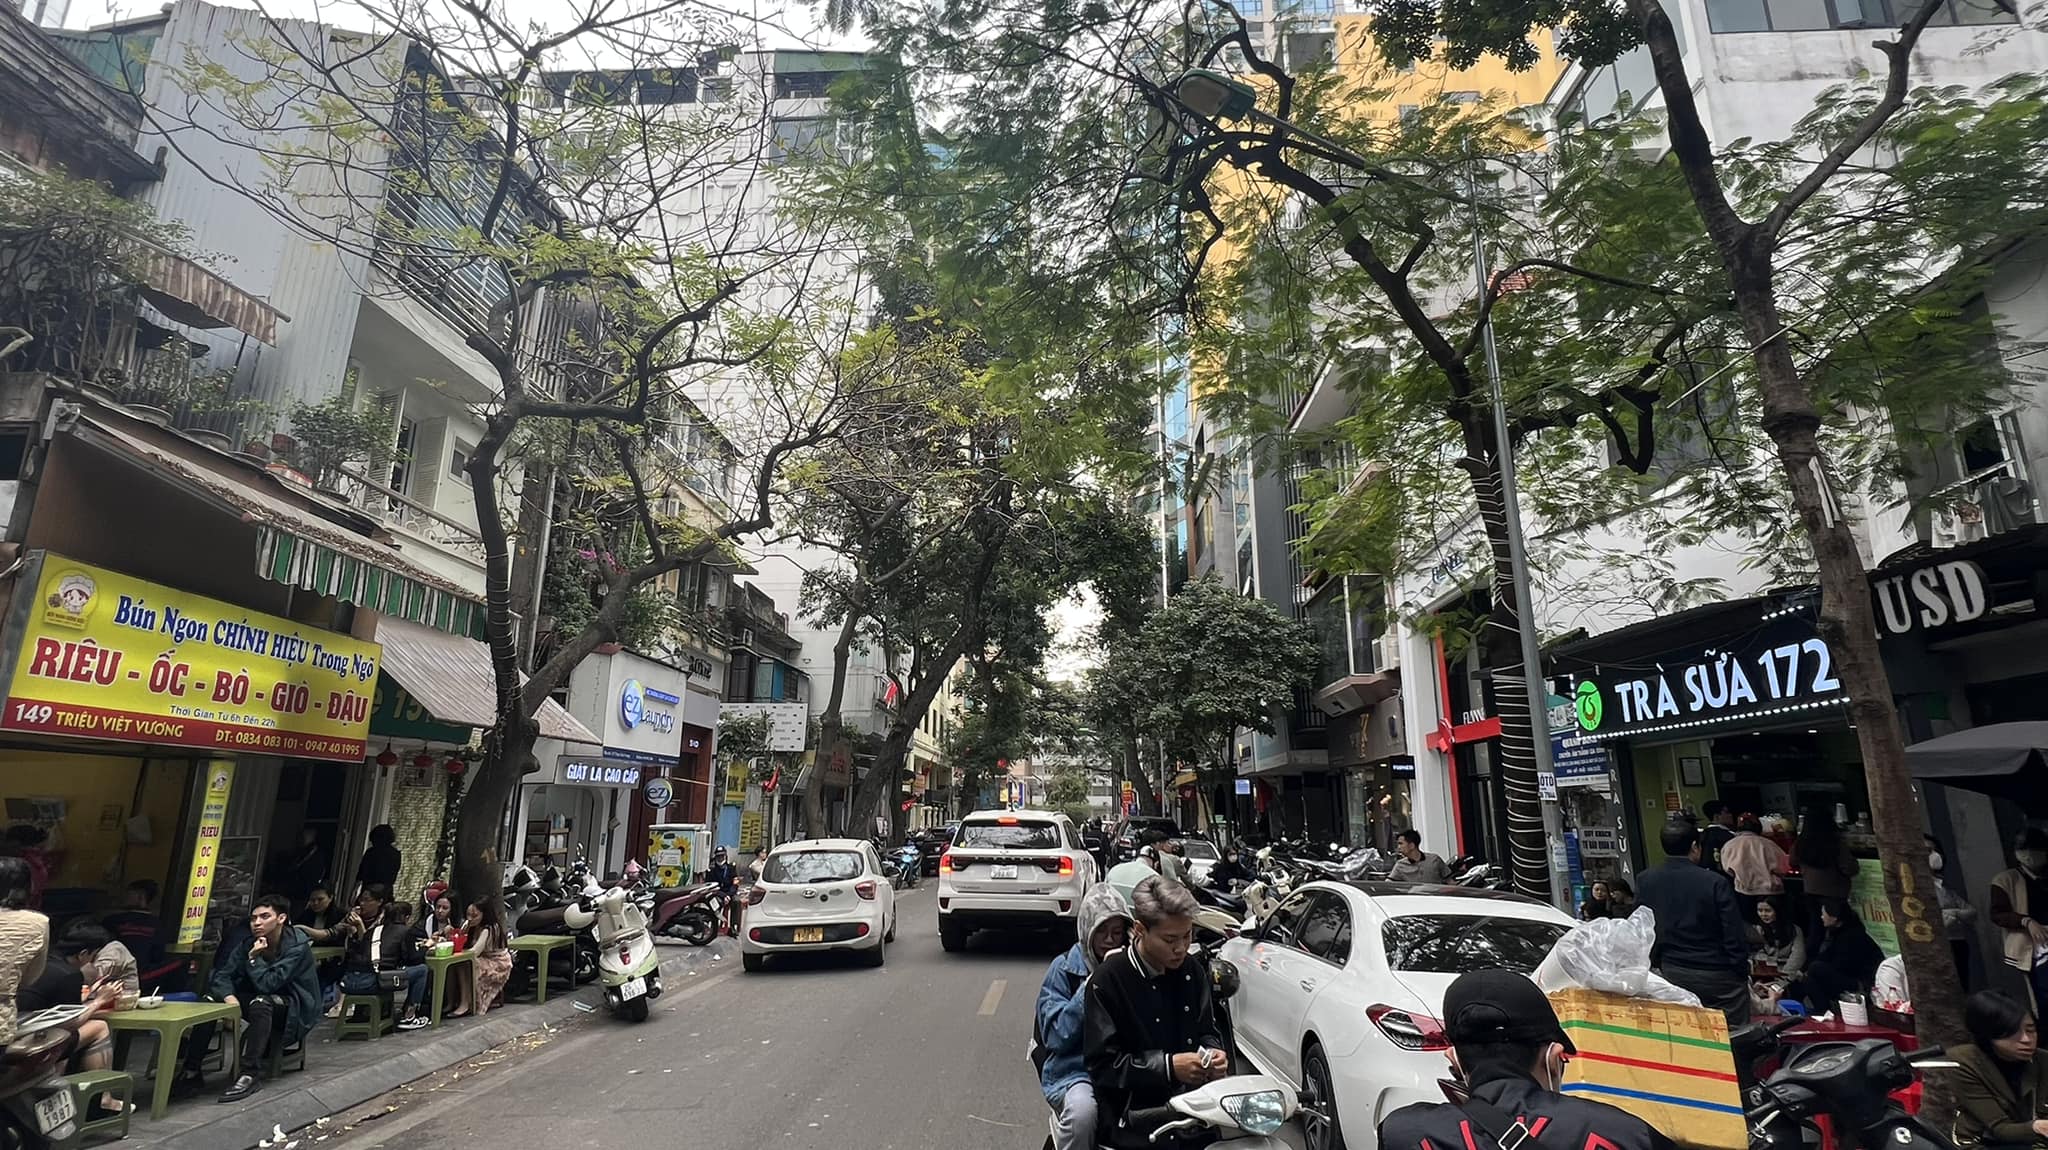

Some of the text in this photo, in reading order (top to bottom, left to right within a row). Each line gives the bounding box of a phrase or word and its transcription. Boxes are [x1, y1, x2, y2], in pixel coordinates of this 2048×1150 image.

[1874, 560, 1986, 639] USD
[115, 595, 155, 630] Bún
[161, 606, 207, 643] Ngon
[214, 619, 269, 655] CHÍNH
[270, 632, 309, 667] HIỆU
[312, 644, 348, 678] Trong
[30, 638, 122, 685] RIÊU
[149, 649, 189, 697] ỐC
[212, 668, 249, 705] BÒ
[271, 681, 309, 714] GIÒ
[326, 689, 368, 726] ĐẬU
[1614, 662, 1680, 723] TRÀ
[1684, 648, 1758, 713] SỮA
[1758, 638, 1841, 699] 172
[624, 694, 641, 716] ez
[16, 703, 184, 738] 149 TRIỆU VIỆT VƯƠNG
[261, 718, 276, 728] 22h
[235, 731, 260, 745] 0834
[263, 735, 281, 748] 083
[283, 737, 298, 750] 101
[305, 740, 326, 752] 0947
[604, 767, 621, 783] CAO
[647, 787, 666, 799] ez
